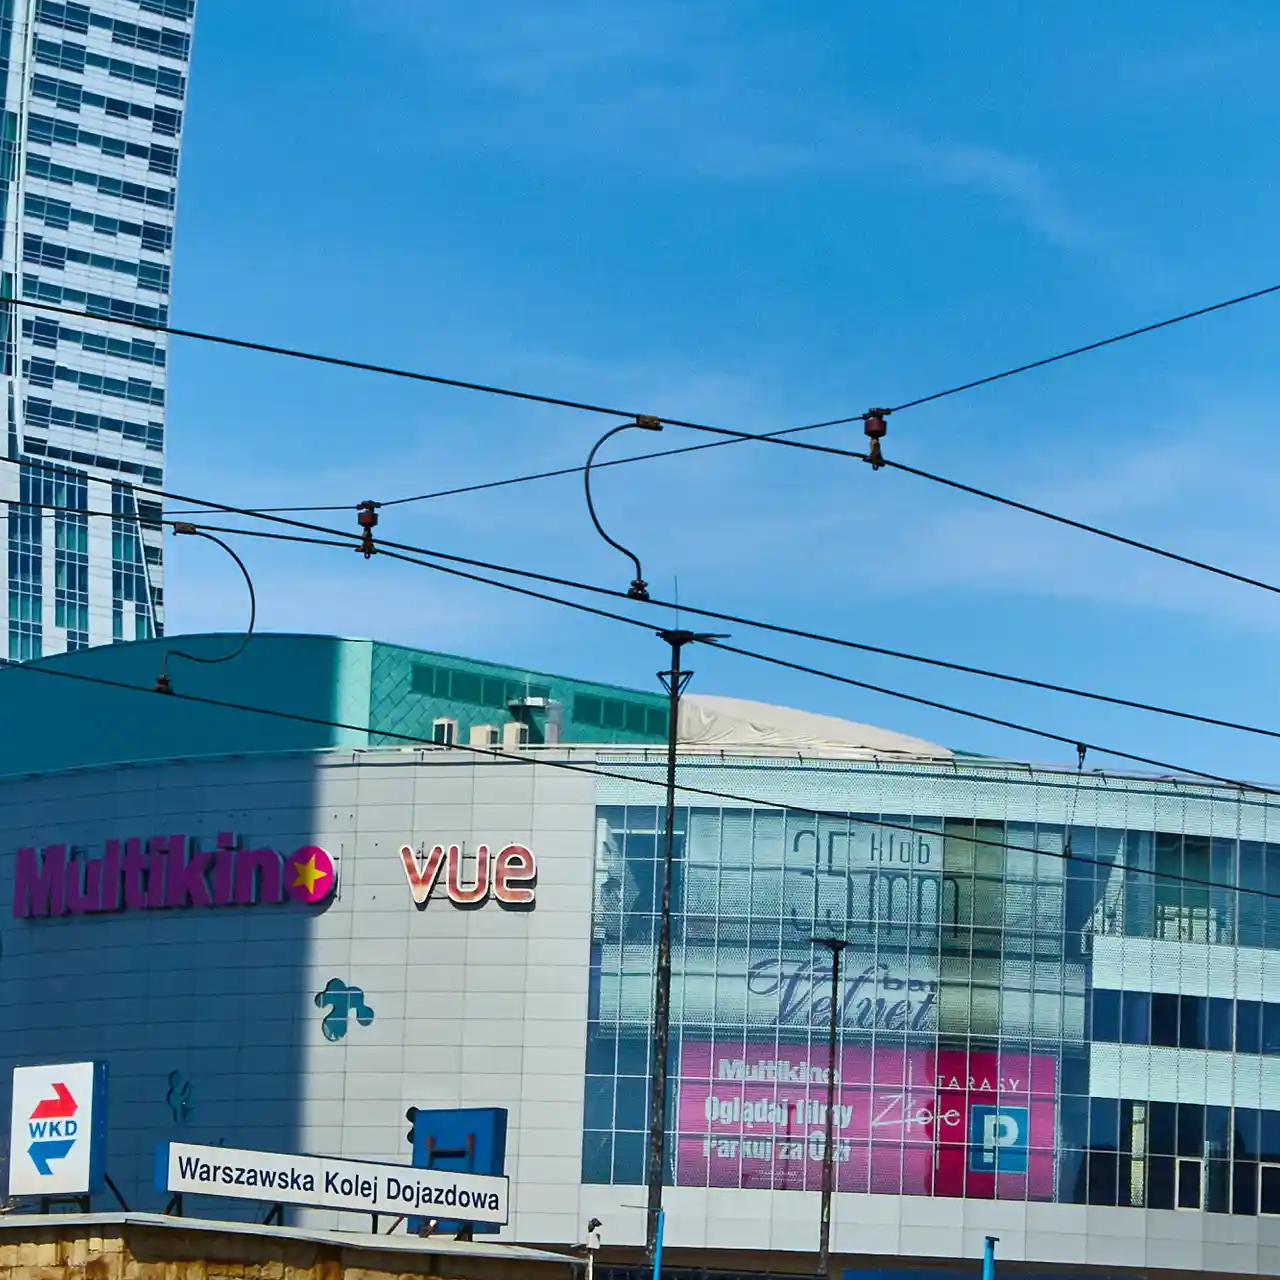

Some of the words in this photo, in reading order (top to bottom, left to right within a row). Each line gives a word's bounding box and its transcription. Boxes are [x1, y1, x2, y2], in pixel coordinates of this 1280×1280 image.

[13, 831, 336, 918] Multikino
[747, 958, 939, 1032] Velvet
[718, 1058, 840, 1082] Multikino
[937, 1075, 1020, 1092] TARASY
[704, 1096, 789, 1128] Oglądaj
[28, 1120, 78, 1139] WKD
[982, 1114, 1019, 1164] P
[778, 1141, 804, 1160] za
[178, 1156, 315, 1192] Warszawska
[324, 1171, 379, 1204] Kolej
[386, 1177, 499, 1211] Dojazdowa
